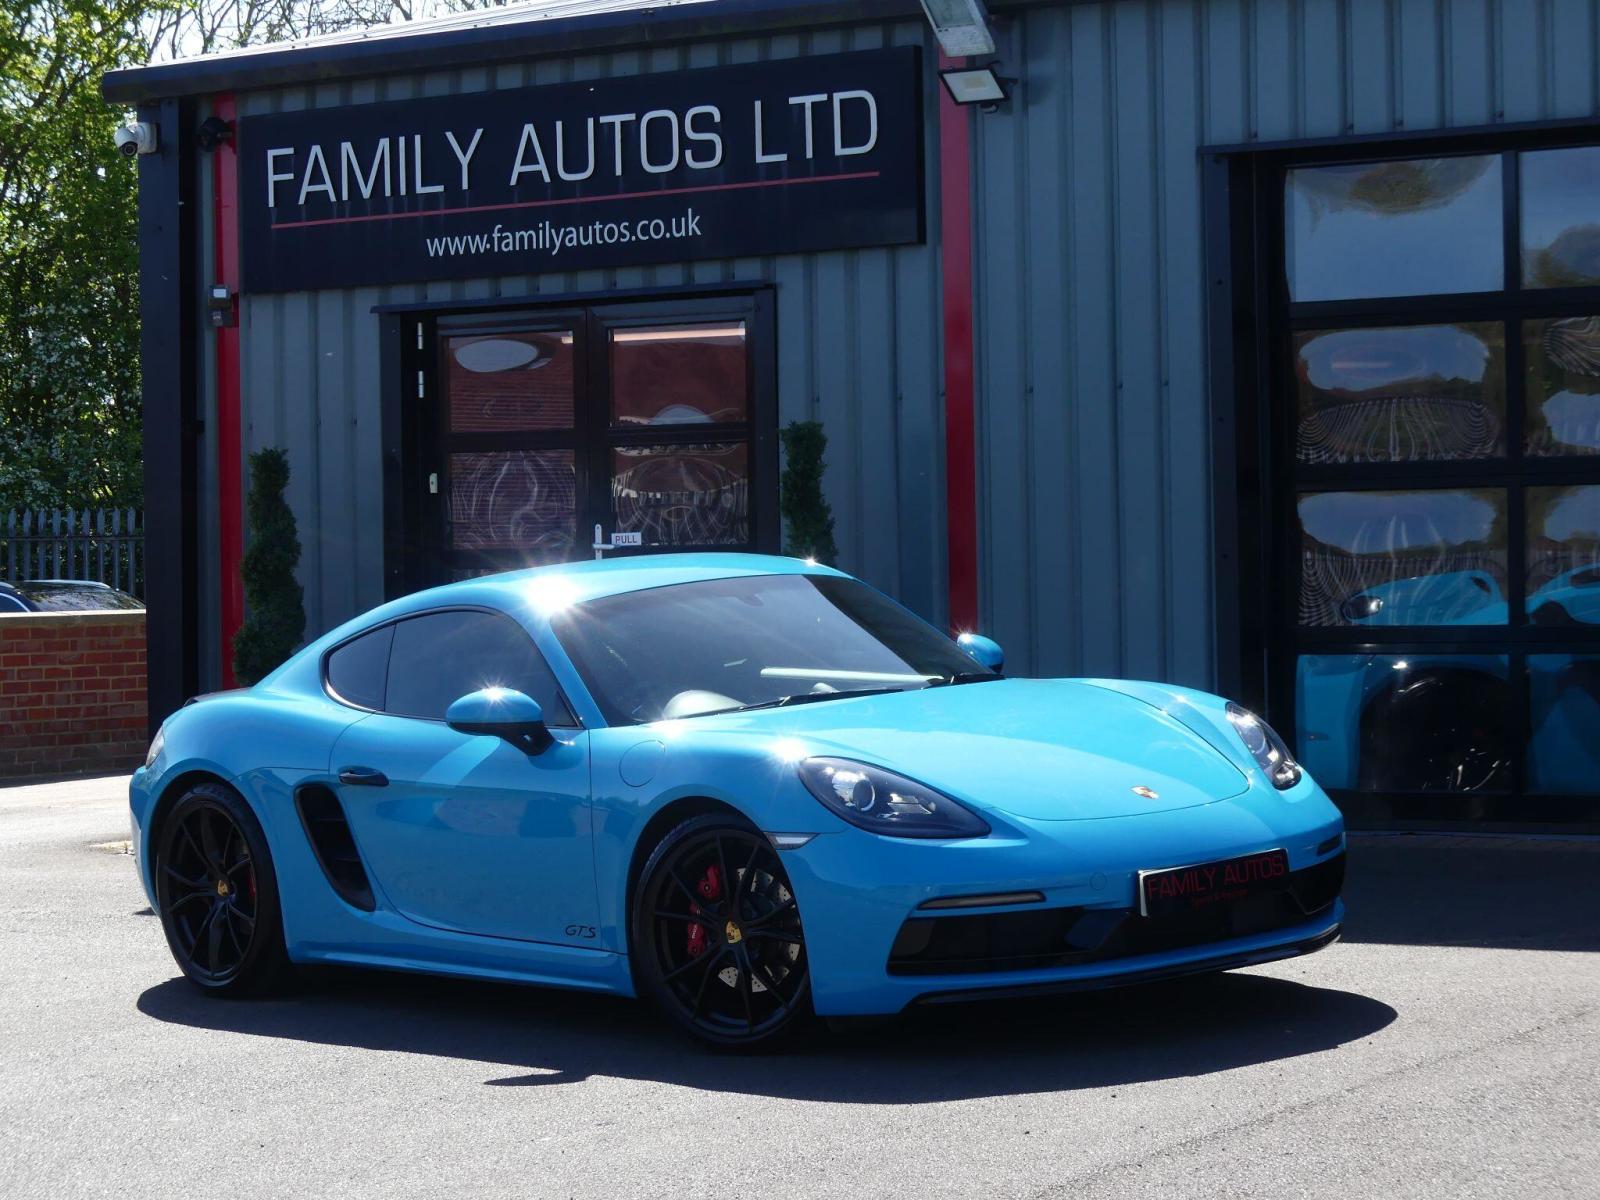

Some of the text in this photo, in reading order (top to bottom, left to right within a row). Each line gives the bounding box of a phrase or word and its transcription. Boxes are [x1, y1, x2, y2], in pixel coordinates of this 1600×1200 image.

[266, 89, 879, 208] FAMILY AUTOS LTD
[426, 207, 702, 257] www.familyautos.co.uk
[615, 535, 638, 544] PULL
[1147, 855, 1286, 897] FAMILY AUTOS
[565, 924, 597, 939] GTS
